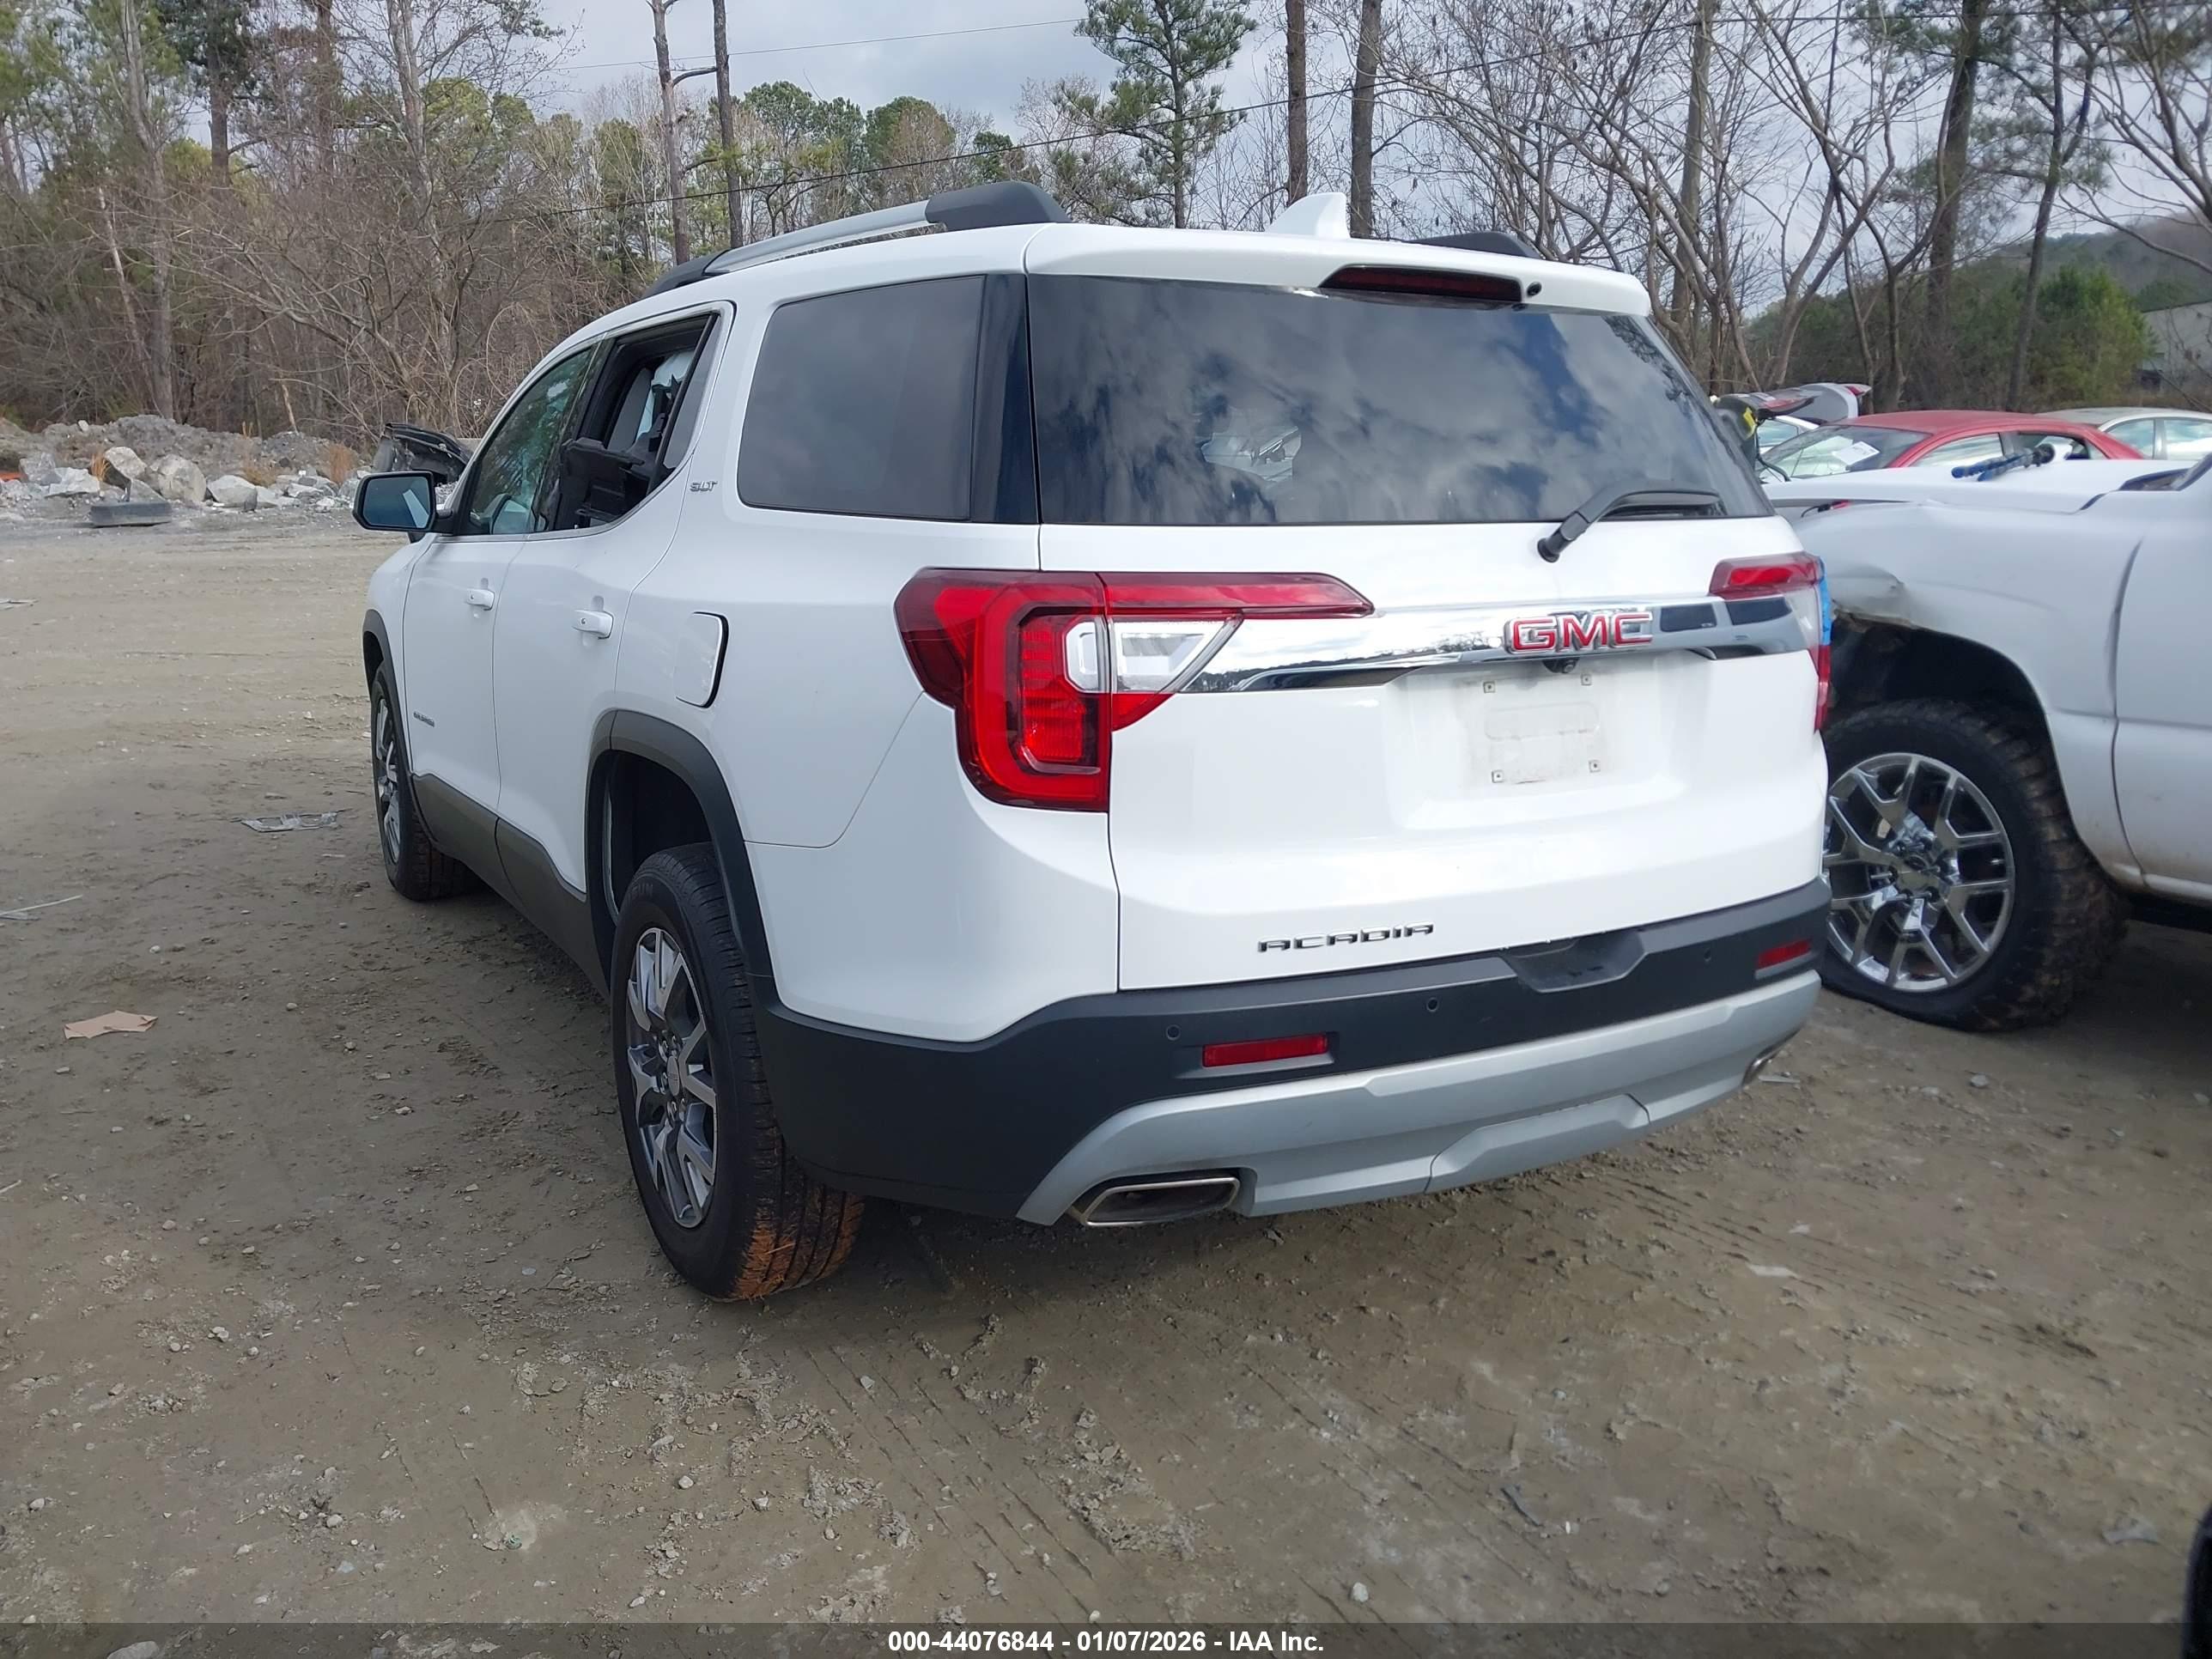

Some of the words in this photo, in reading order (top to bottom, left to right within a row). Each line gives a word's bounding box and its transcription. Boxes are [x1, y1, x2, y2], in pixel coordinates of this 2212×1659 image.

[690, 481, 718, 492] SLT
[1505, 611, 1653, 654] GMC
[1258, 921, 1434, 952] ACADIA
